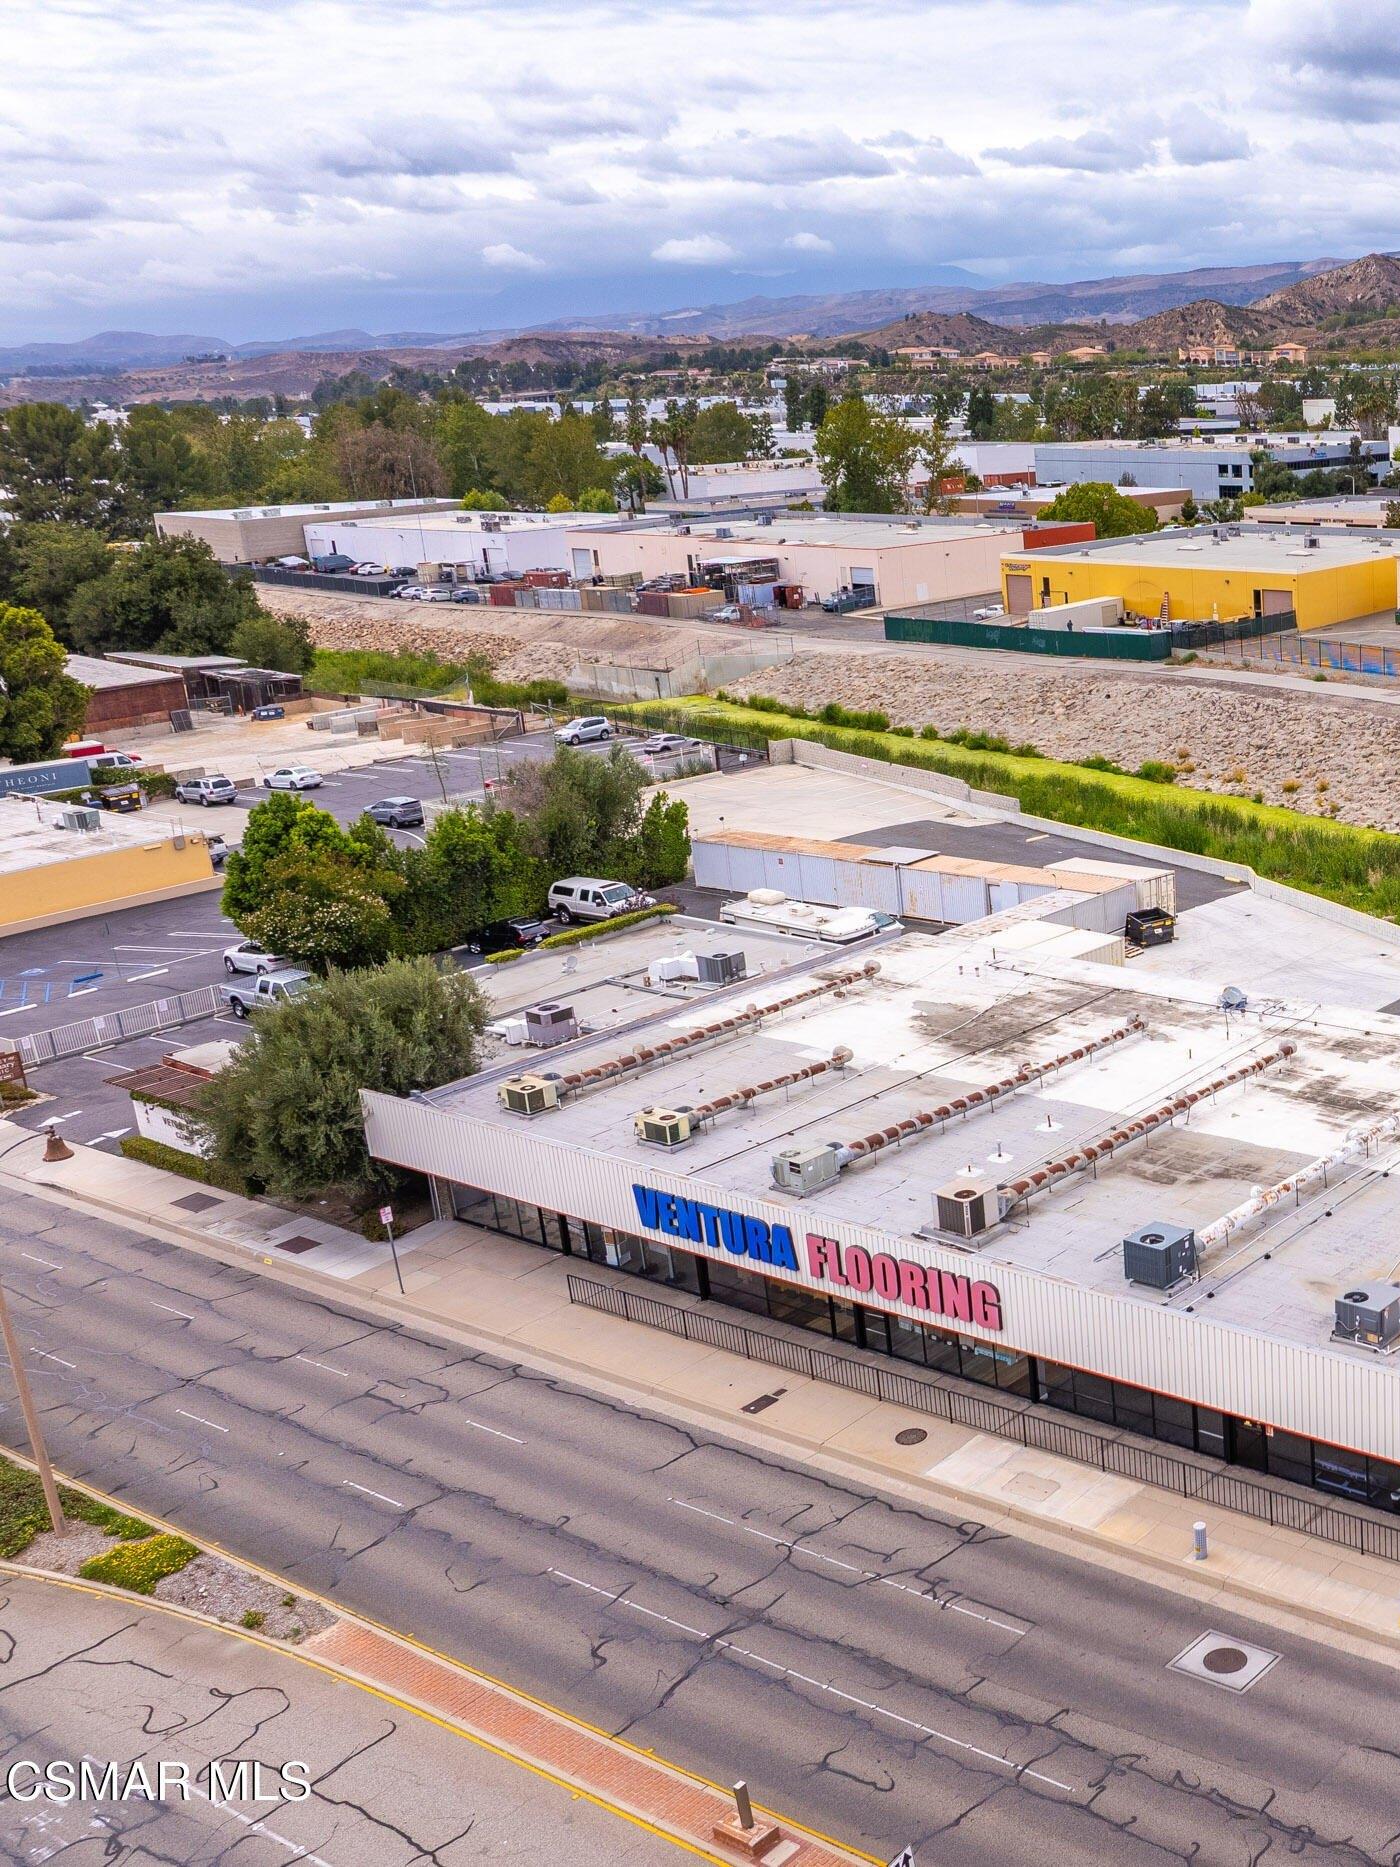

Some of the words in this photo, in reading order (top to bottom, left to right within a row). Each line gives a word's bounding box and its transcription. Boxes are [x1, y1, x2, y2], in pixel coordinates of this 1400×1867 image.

[0, 772, 57, 787] HEONI
[632, 1183, 800, 1271] VENTURA
[806, 1232, 1003, 1331] FLOORING
